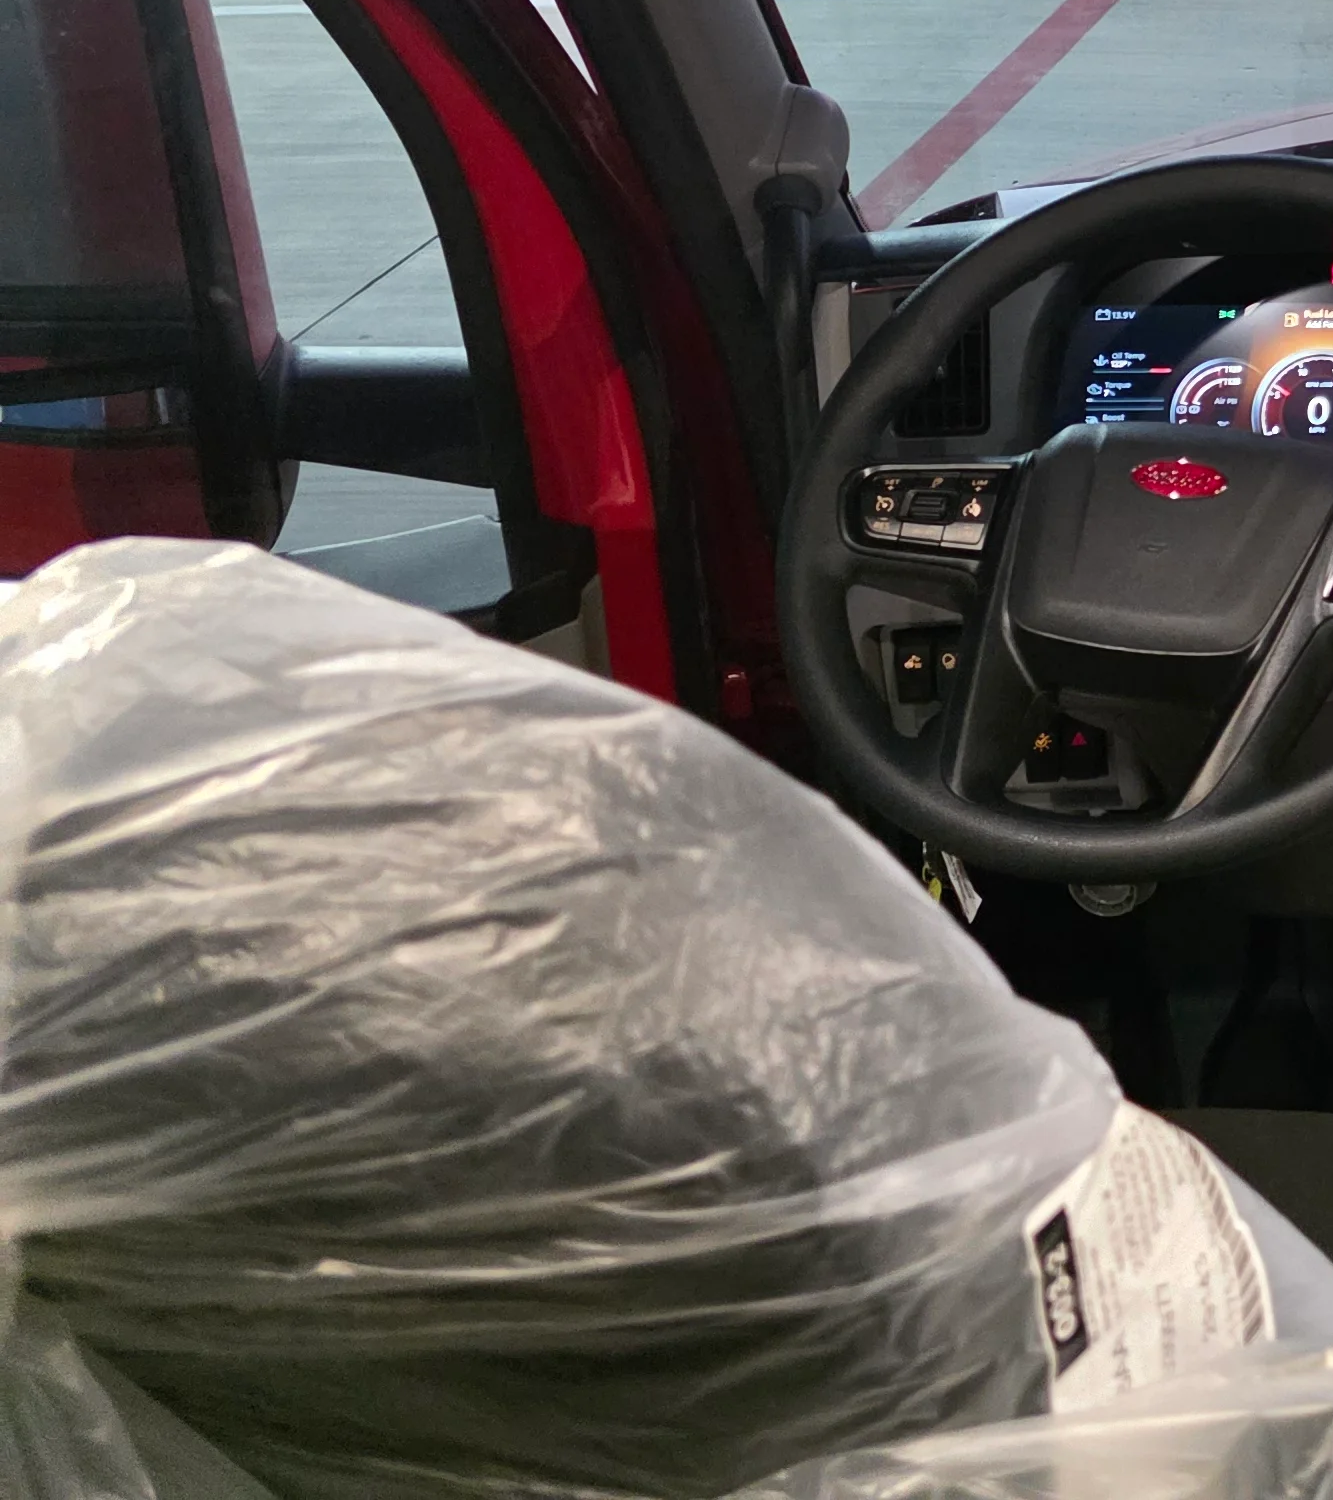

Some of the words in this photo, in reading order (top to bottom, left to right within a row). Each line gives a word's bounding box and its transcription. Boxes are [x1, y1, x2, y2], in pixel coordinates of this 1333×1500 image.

[1303, 308, 1324, 319] Fuel
[1111, 351, 1123, 360] Oil
[1124, 352, 1146, 361] Temp
[1104, 381, 1132, 390] Torque
[1214, 397, 1226, 405] Air
[1307, 396, 1330, 426] 0
[1102, 413, 1125, 422] Boost
